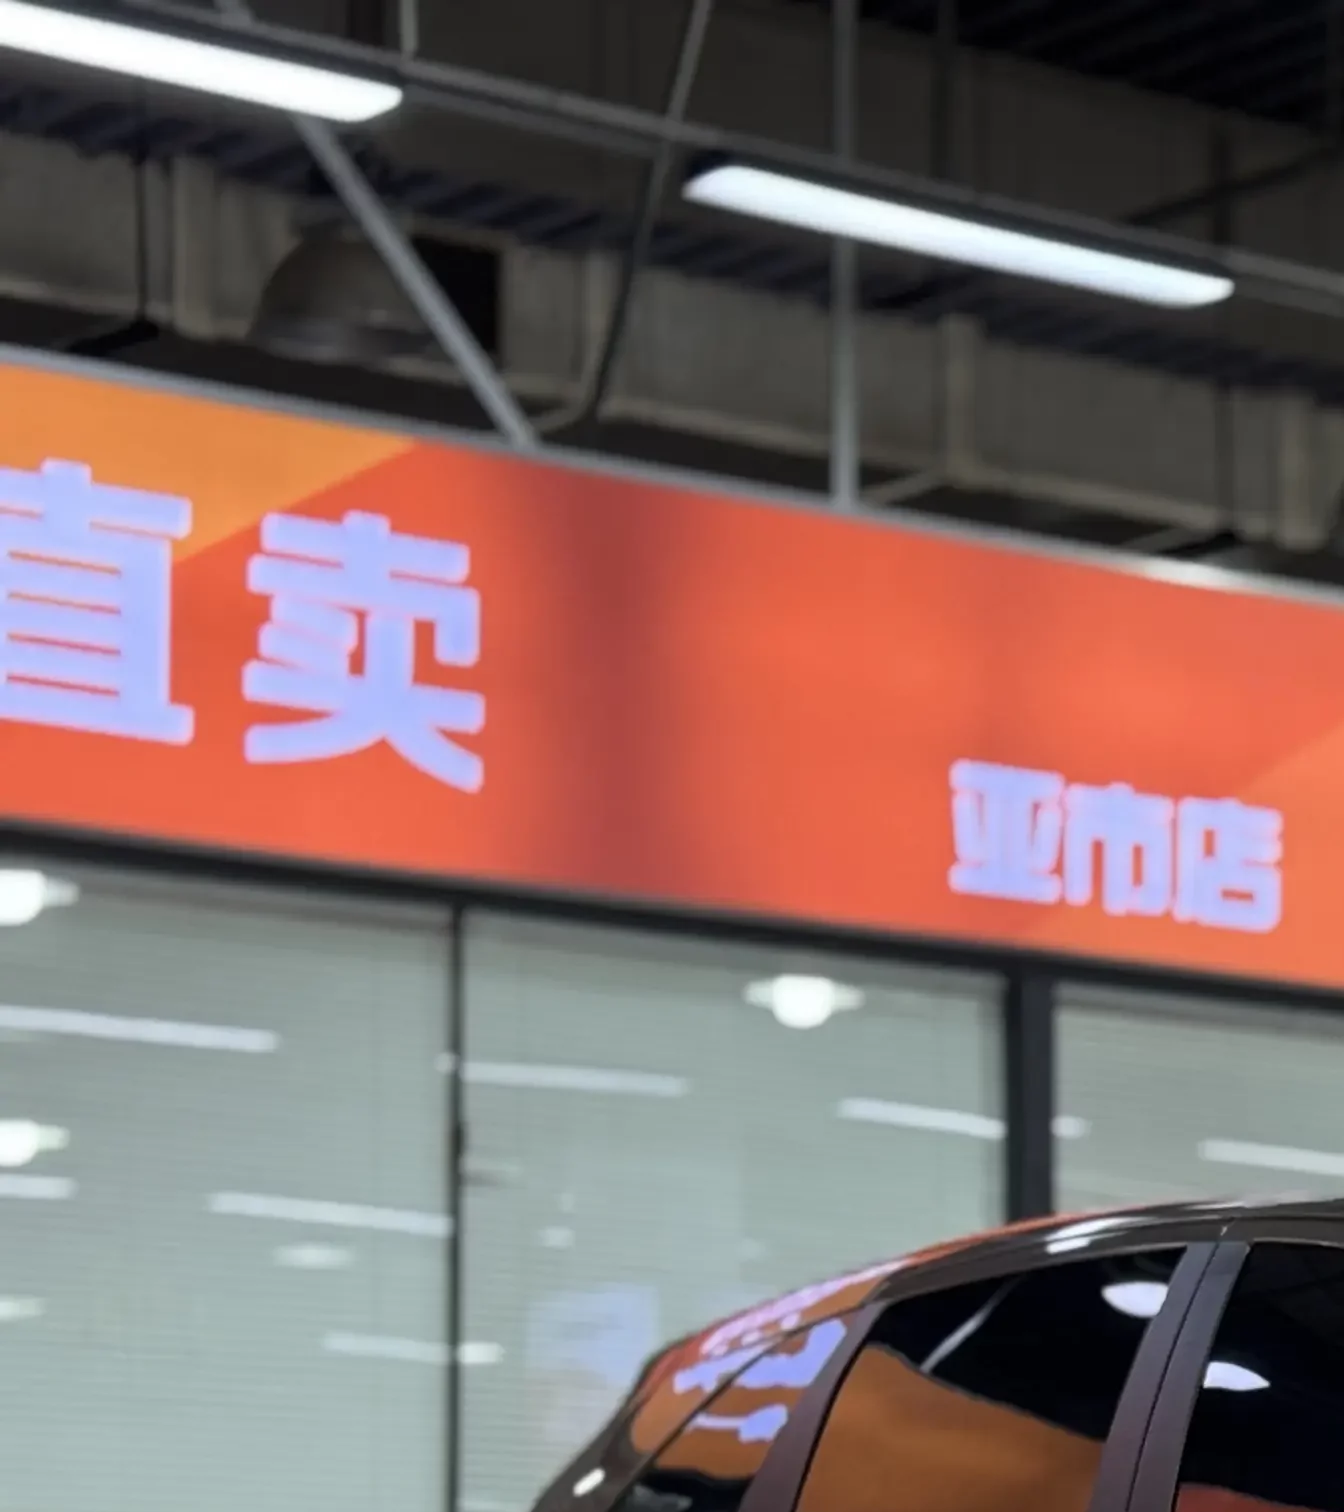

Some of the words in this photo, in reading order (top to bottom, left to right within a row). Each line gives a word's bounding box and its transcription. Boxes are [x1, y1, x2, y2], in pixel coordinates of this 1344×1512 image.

[0, 458, 485, 793] 直卖
[949, 758, 1283, 933] 亚市店
